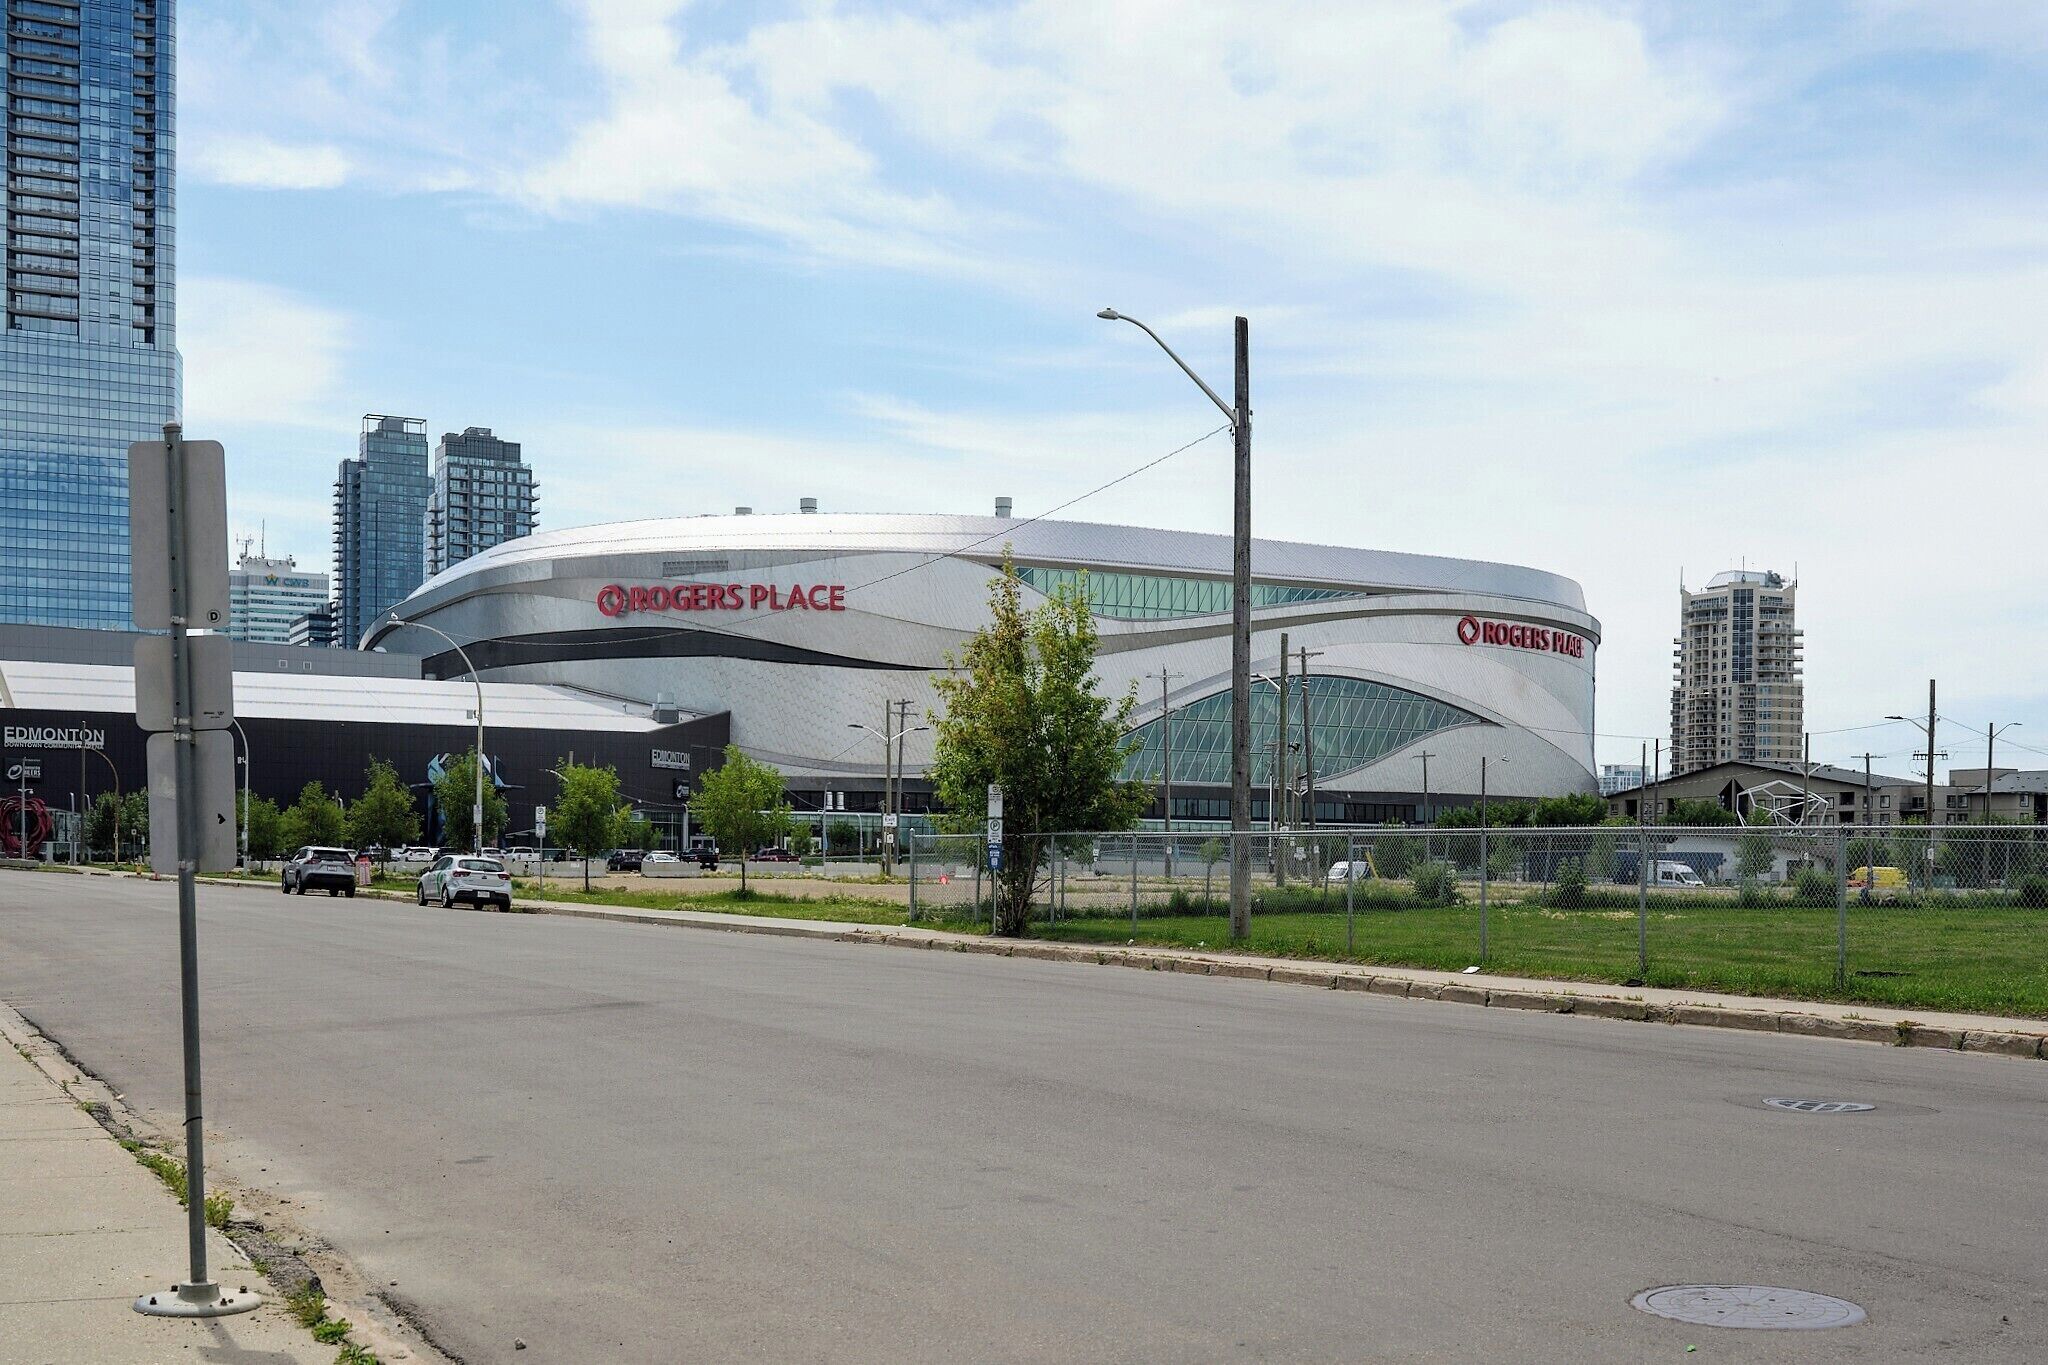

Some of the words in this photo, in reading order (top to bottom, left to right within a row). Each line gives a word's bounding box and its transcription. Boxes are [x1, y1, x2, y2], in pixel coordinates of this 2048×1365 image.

[284, 578, 310, 588] CWB
[629, 584, 744, 611] ROGERS
[750, 584, 846, 611] PLACE
[1483, 621, 1550, 650] ROGERS
[4, 726, 105, 742] EDMONTON
[651, 749, 690, 764] EDMONTON
